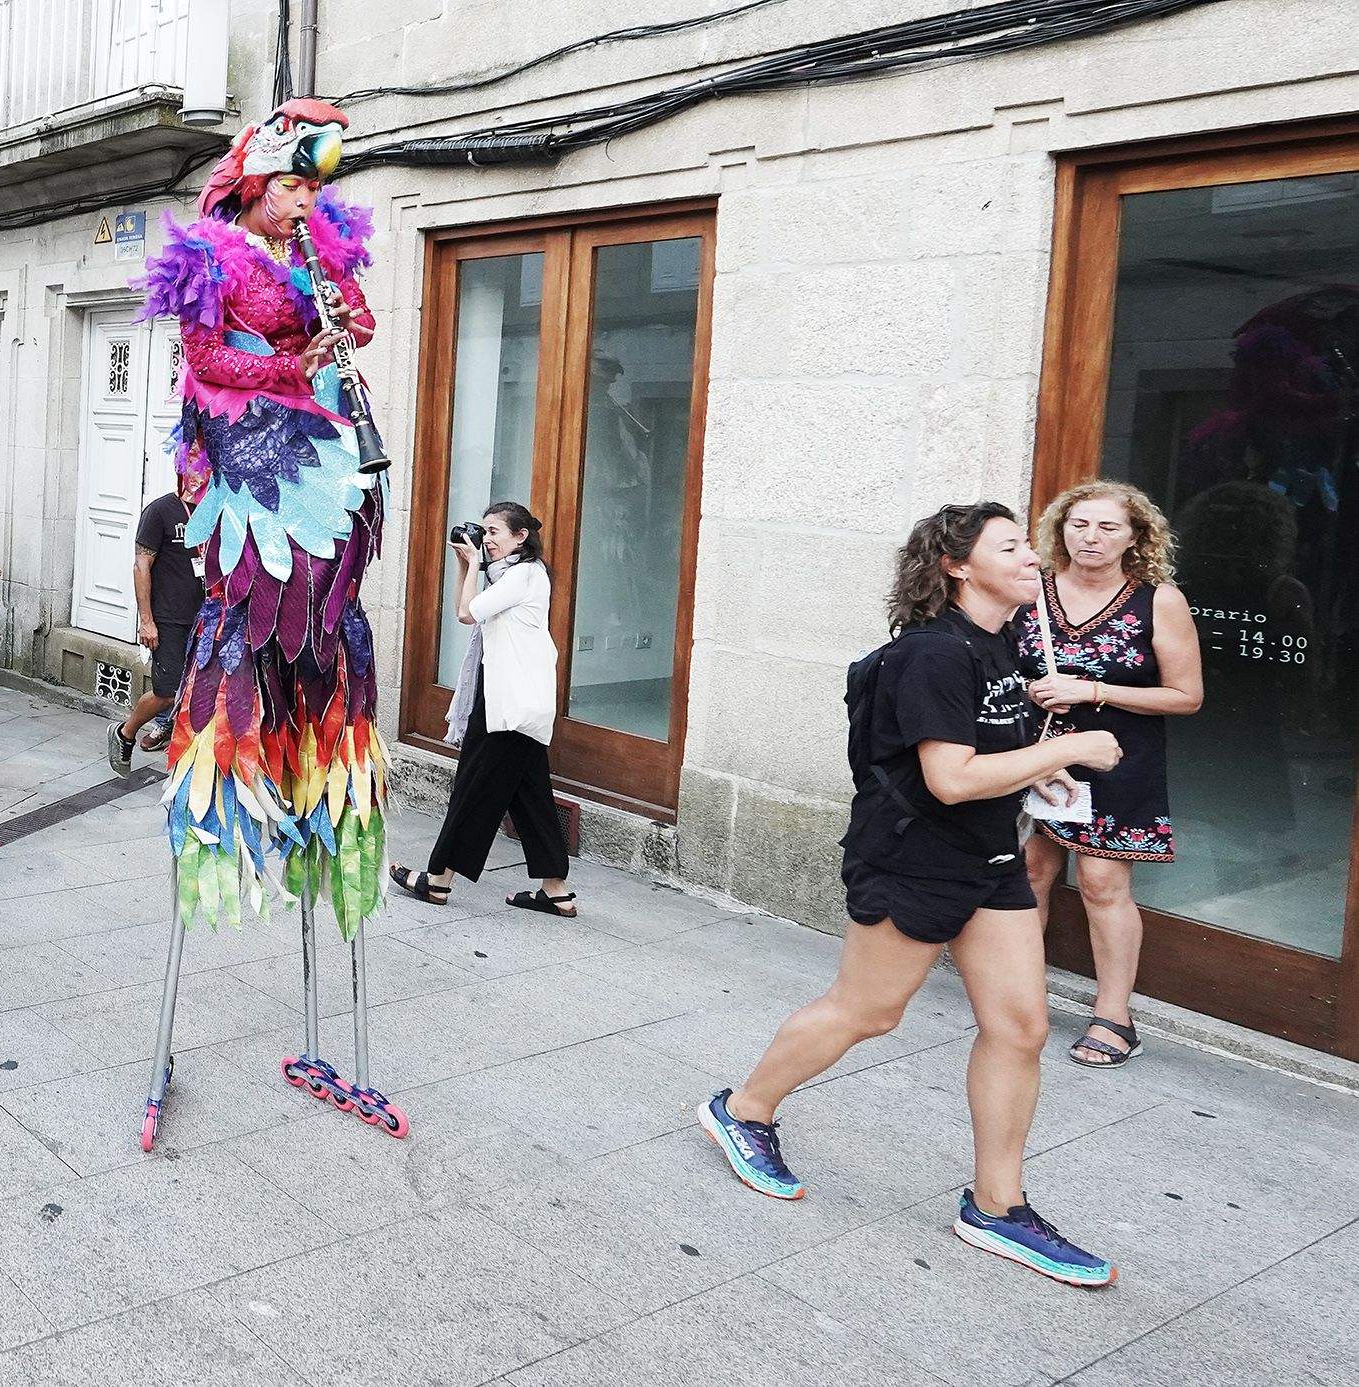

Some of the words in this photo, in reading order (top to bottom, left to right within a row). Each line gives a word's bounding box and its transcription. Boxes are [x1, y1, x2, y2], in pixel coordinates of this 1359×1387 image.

[1240, 629, 1308, 649] 14.00
[1240, 644, 1306, 664] 19.30
[725, 1123, 755, 1160] HOKA
